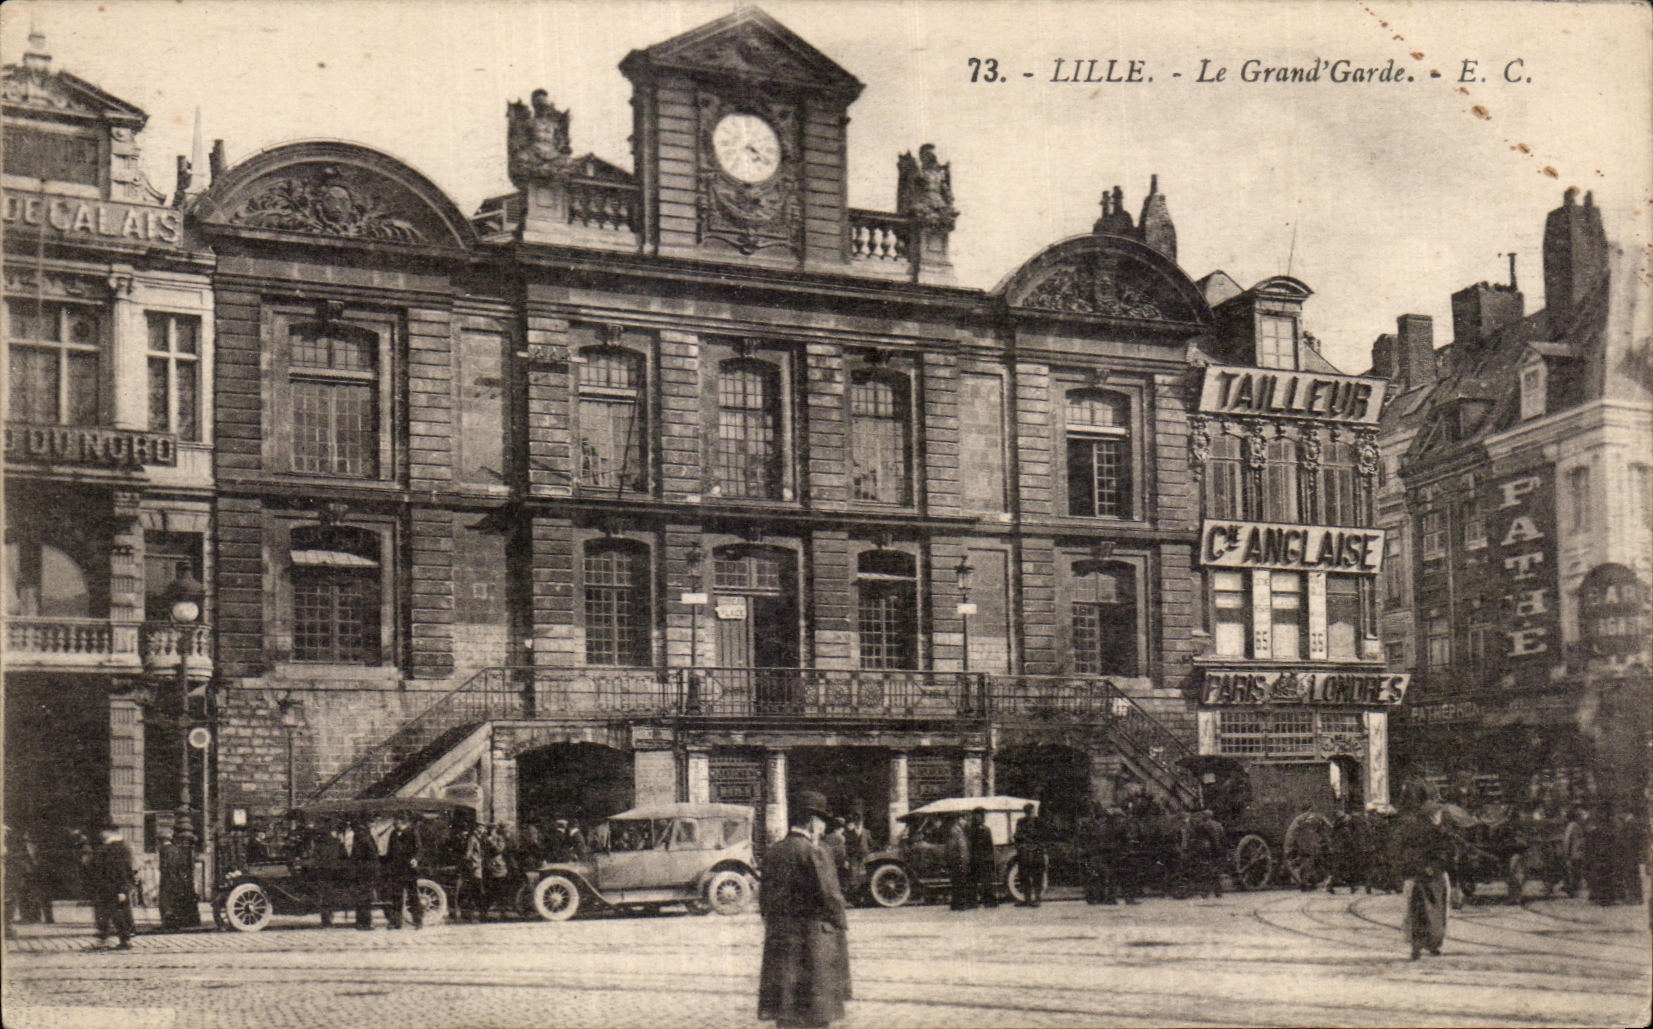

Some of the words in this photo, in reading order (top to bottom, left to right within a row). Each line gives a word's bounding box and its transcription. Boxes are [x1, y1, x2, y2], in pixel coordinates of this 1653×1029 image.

[49, 198, 179, 244] CALAIS
[1214, 370, 1372, 420] TAILLEUR
[78, 432, 172, 464] NORD
[1242, 526, 1380, 571] ANGLAISE
[1205, 674, 1268, 701] PARIS
[1306, 674, 1404, 704] LONDRES
